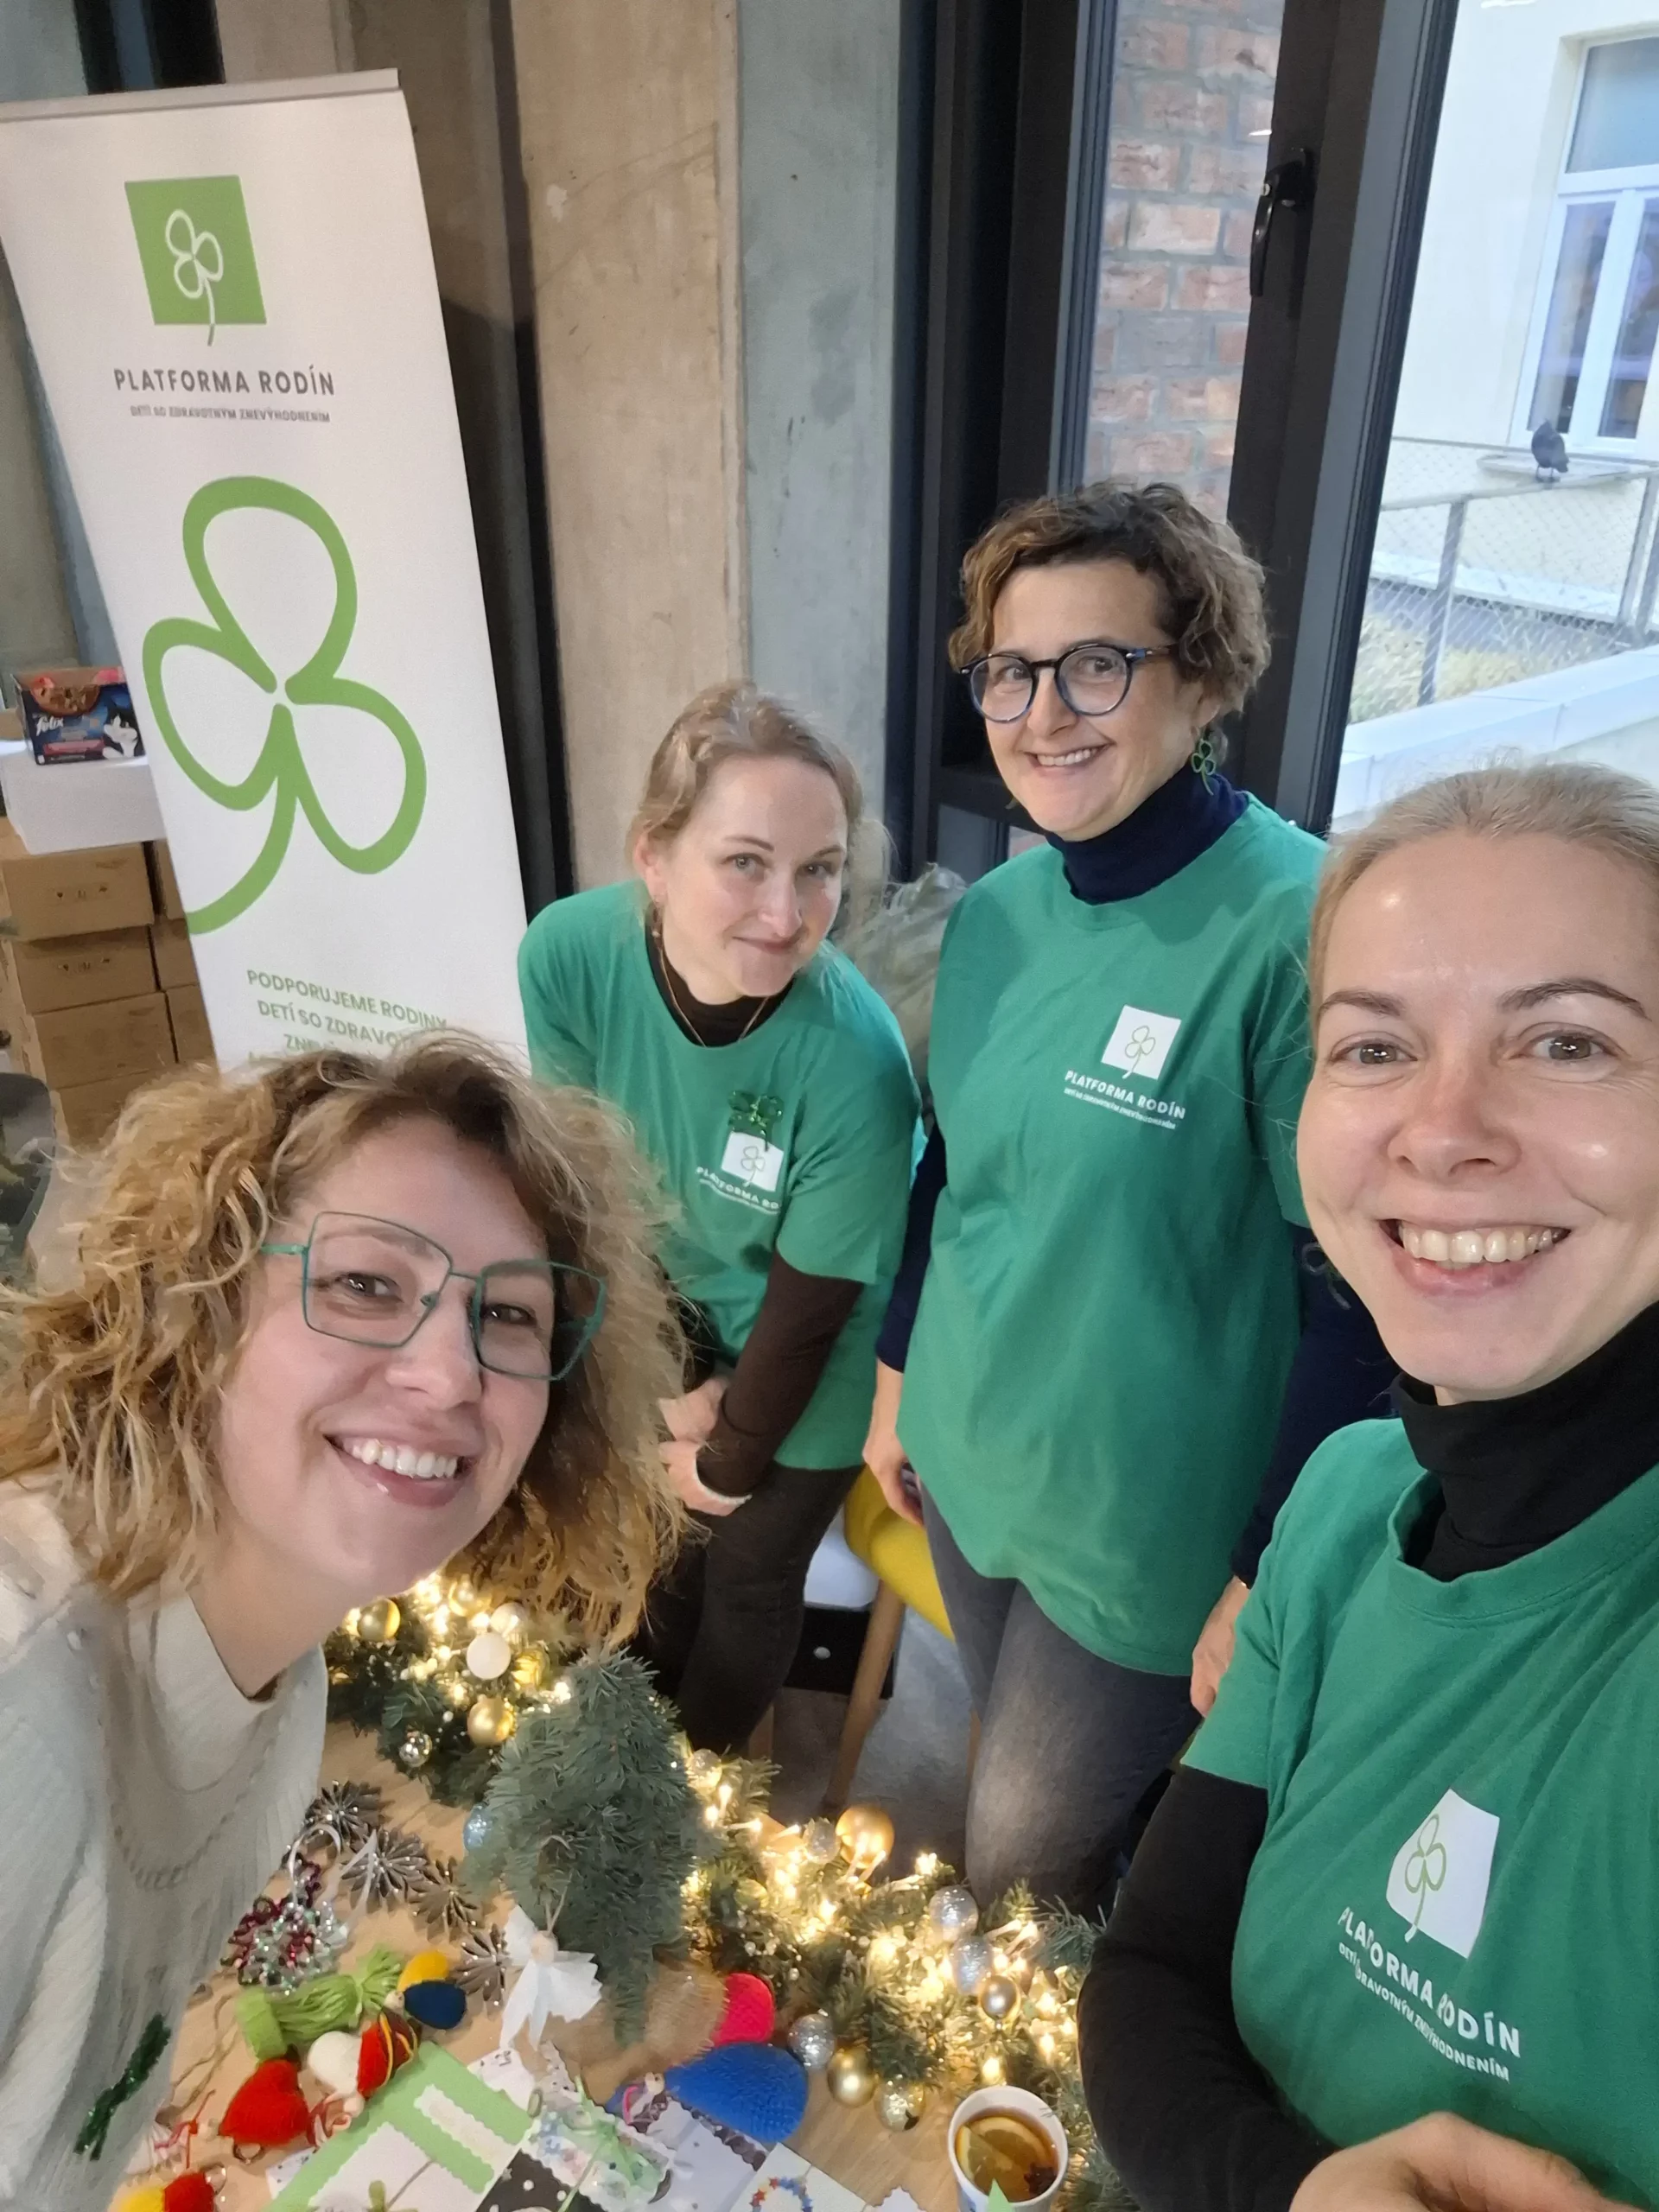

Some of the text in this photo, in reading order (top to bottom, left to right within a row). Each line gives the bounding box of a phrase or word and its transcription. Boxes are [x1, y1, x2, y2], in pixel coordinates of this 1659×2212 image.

[113, 364, 335, 396] PLATFORMA RODÍN
[247, 969, 448, 1031] PODPORUJEME RODINY
[257, 1000, 296, 1022] DETÍ
[298, 1008, 322, 1028] SO
[1064, 1070, 1135, 1104] PLATFORMA
[1137, 1094, 1186, 1120] RODÍN
